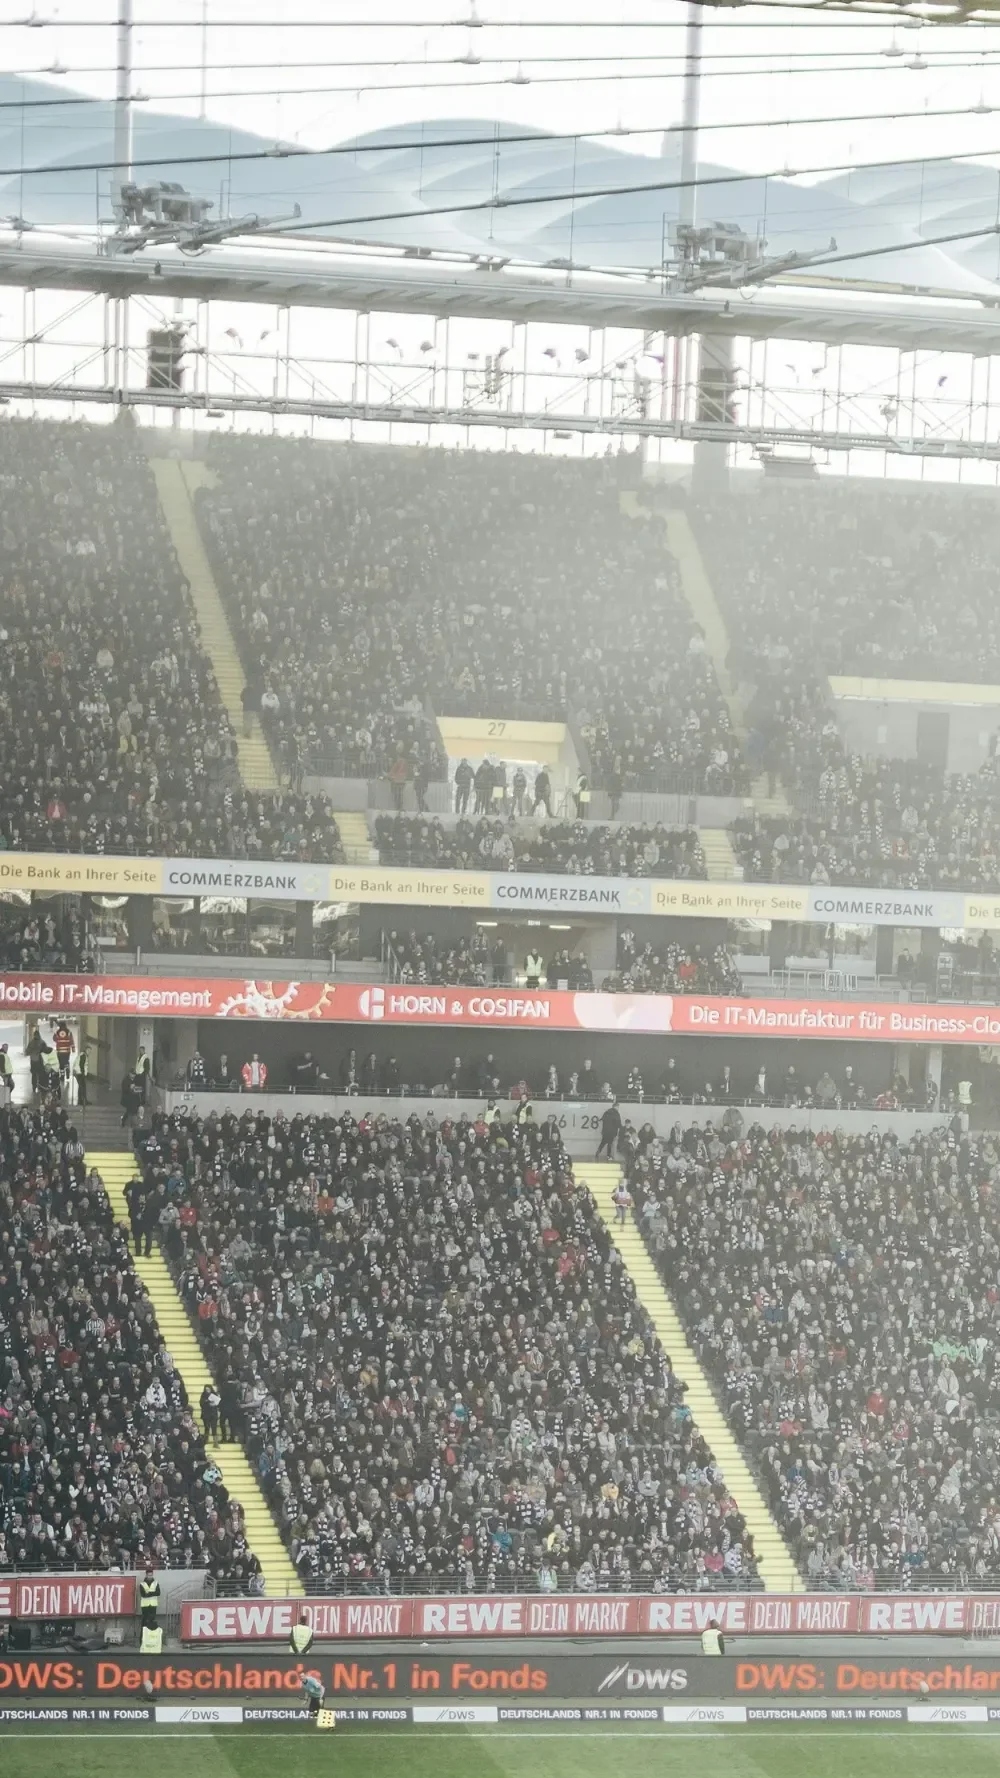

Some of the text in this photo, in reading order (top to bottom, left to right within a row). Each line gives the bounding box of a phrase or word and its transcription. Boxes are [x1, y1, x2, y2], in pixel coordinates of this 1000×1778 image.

[488, 722, 506, 736] 27
[1, 864, 157, 883] Die Bank an Ihrer Seite
[169, 872, 297, 890] COMMERZBANK
[335, 878, 485, 896] Die Bank an Ihrer Seite
[497, 886, 620, 903] COMMERZBANK
[657, 892, 802, 910] Die Bank an Ihrer Seite
[814, 899, 933, 917] COMMERZBANK
[969, 906, 990, 918] Die
[60, 985, 212, 1008] IT-Management
[390, 996, 550, 1018] HORN & COSIFAN
[690, 1005, 719, 1024] Die
[725, 1007, 854, 1029] IT-Manufaktur
[859, 1011, 885, 1029] für
[581, 1115, 599, 1130] 28
[21, 1585, 60, 1615] DEIN
[68, 1584, 126, 1614] MARKT
[191, 1604, 403, 1636] REWE DEIN MARKT
[423, 1602, 629, 1632] REWE DEIN MARKT
[649, 1601, 851, 1630] REWE DEIN MARKT
[869, 1601, 965, 1630] REWE
[411, 1664, 440, 1690] in
[451, 1664, 548, 1691] Fonds
[627, 1668, 688, 1690] DWS
[736, 1663, 825, 1690] DWS:
[72, 1710, 150, 1719] NR.1 IN FONDS
[192, 1710, 220, 1721] DWS
[358, 1710, 369, 1719] IN
[372, 1710, 407, 1719] FONDS
[449, 1711, 475, 1720] DWS
[500, 1709, 658, 1719] DEUTSCHLANDS NR.1 IN FONDS
[698, 1711, 725, 1720] DWS
[749, 1709, 902, 1719] DEUTSCHLANDS NR.1 IN FONDS
[941, 1711, 967, 1720] DWS
